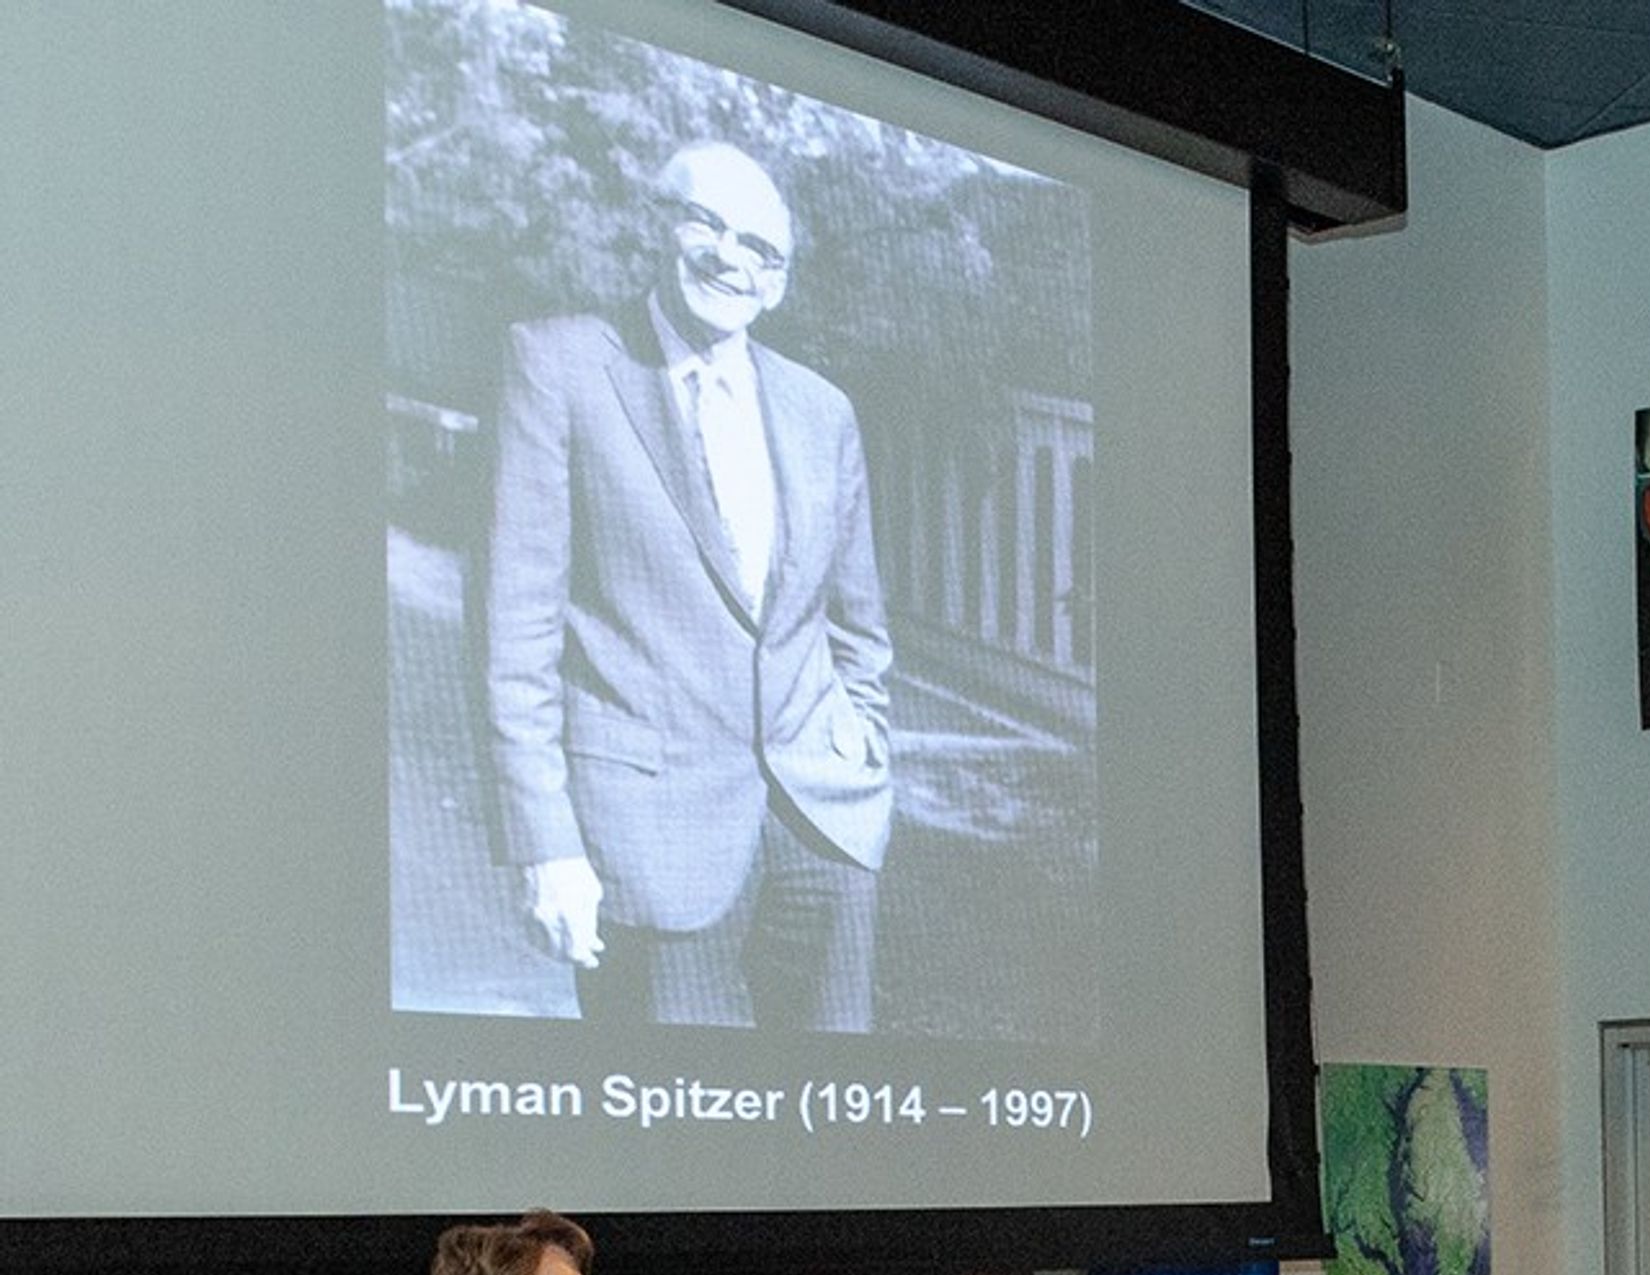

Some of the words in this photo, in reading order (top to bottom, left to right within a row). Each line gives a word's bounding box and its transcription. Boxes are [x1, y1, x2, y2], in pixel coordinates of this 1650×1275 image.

[388, 1067, 583, 1126] Lyman
[601, 1074, 786, 1129] Spitzer
[799, 1080, 927, 1133] (1914
[980, 1087, 1093, 1138] 1997)
